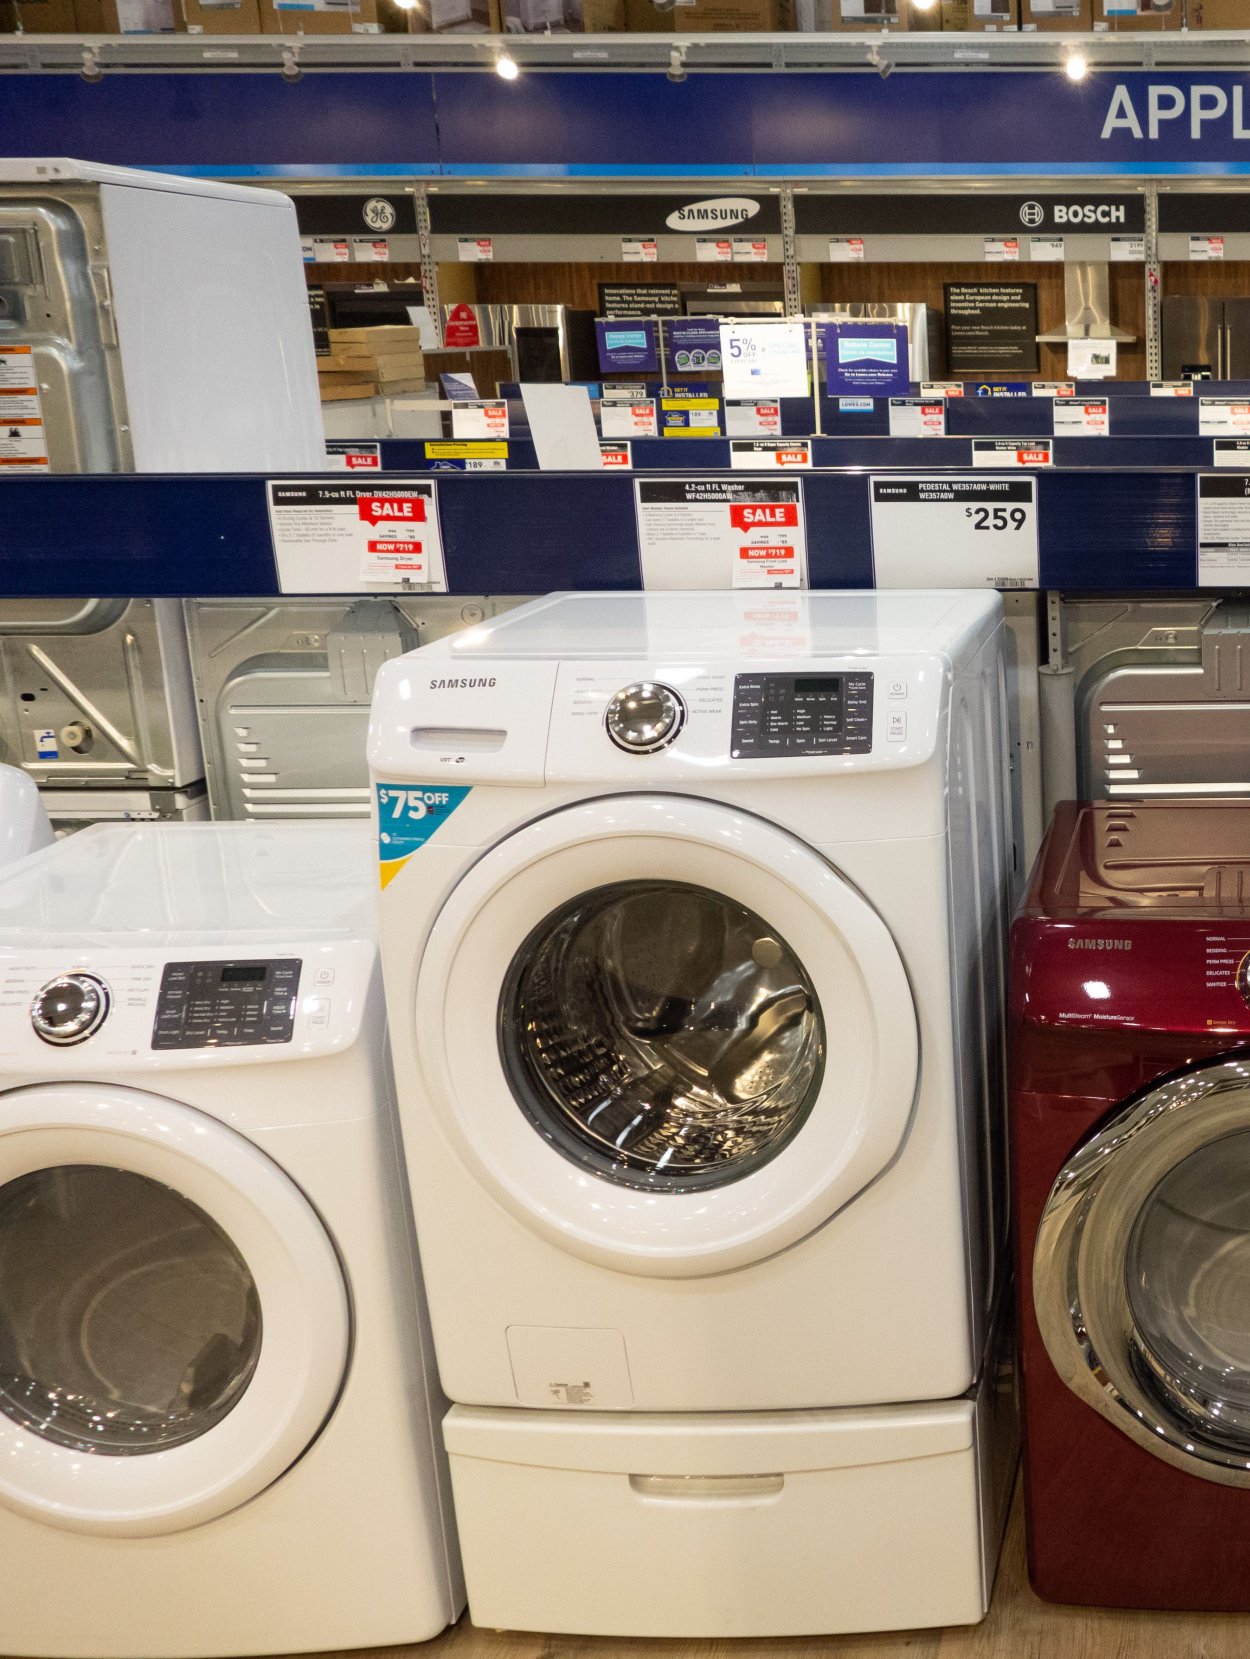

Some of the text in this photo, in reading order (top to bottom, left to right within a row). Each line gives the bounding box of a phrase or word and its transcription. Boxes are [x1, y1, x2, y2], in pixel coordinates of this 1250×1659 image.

[678, 208, 749, 220] SAMSUNG
[1053, 205, 1125, 223] BOSCH
[729, 338, 756, 358] 5%
[351, 457, 372, 465] SALE
[781, 454, 802, 462] SALE
[1023, 453, 1043, 461] SALE
[319, 490, 372, 498] 7.5-cu ft FL Dryer
[371, 502, 413, 517] SALE
[743, 508, 785, 522] SALE
[965, 507, 1027, 531] $259
[376, 543, 413, 551] NOW $719
[429, 677, 496, 689] SAMSUNG
[379, 789, 449, 820] $75 OFF
[1068, 939, 1132, 950] SAMSUNG
[1093, 1013, 1135, 1021] MoistureSensor
